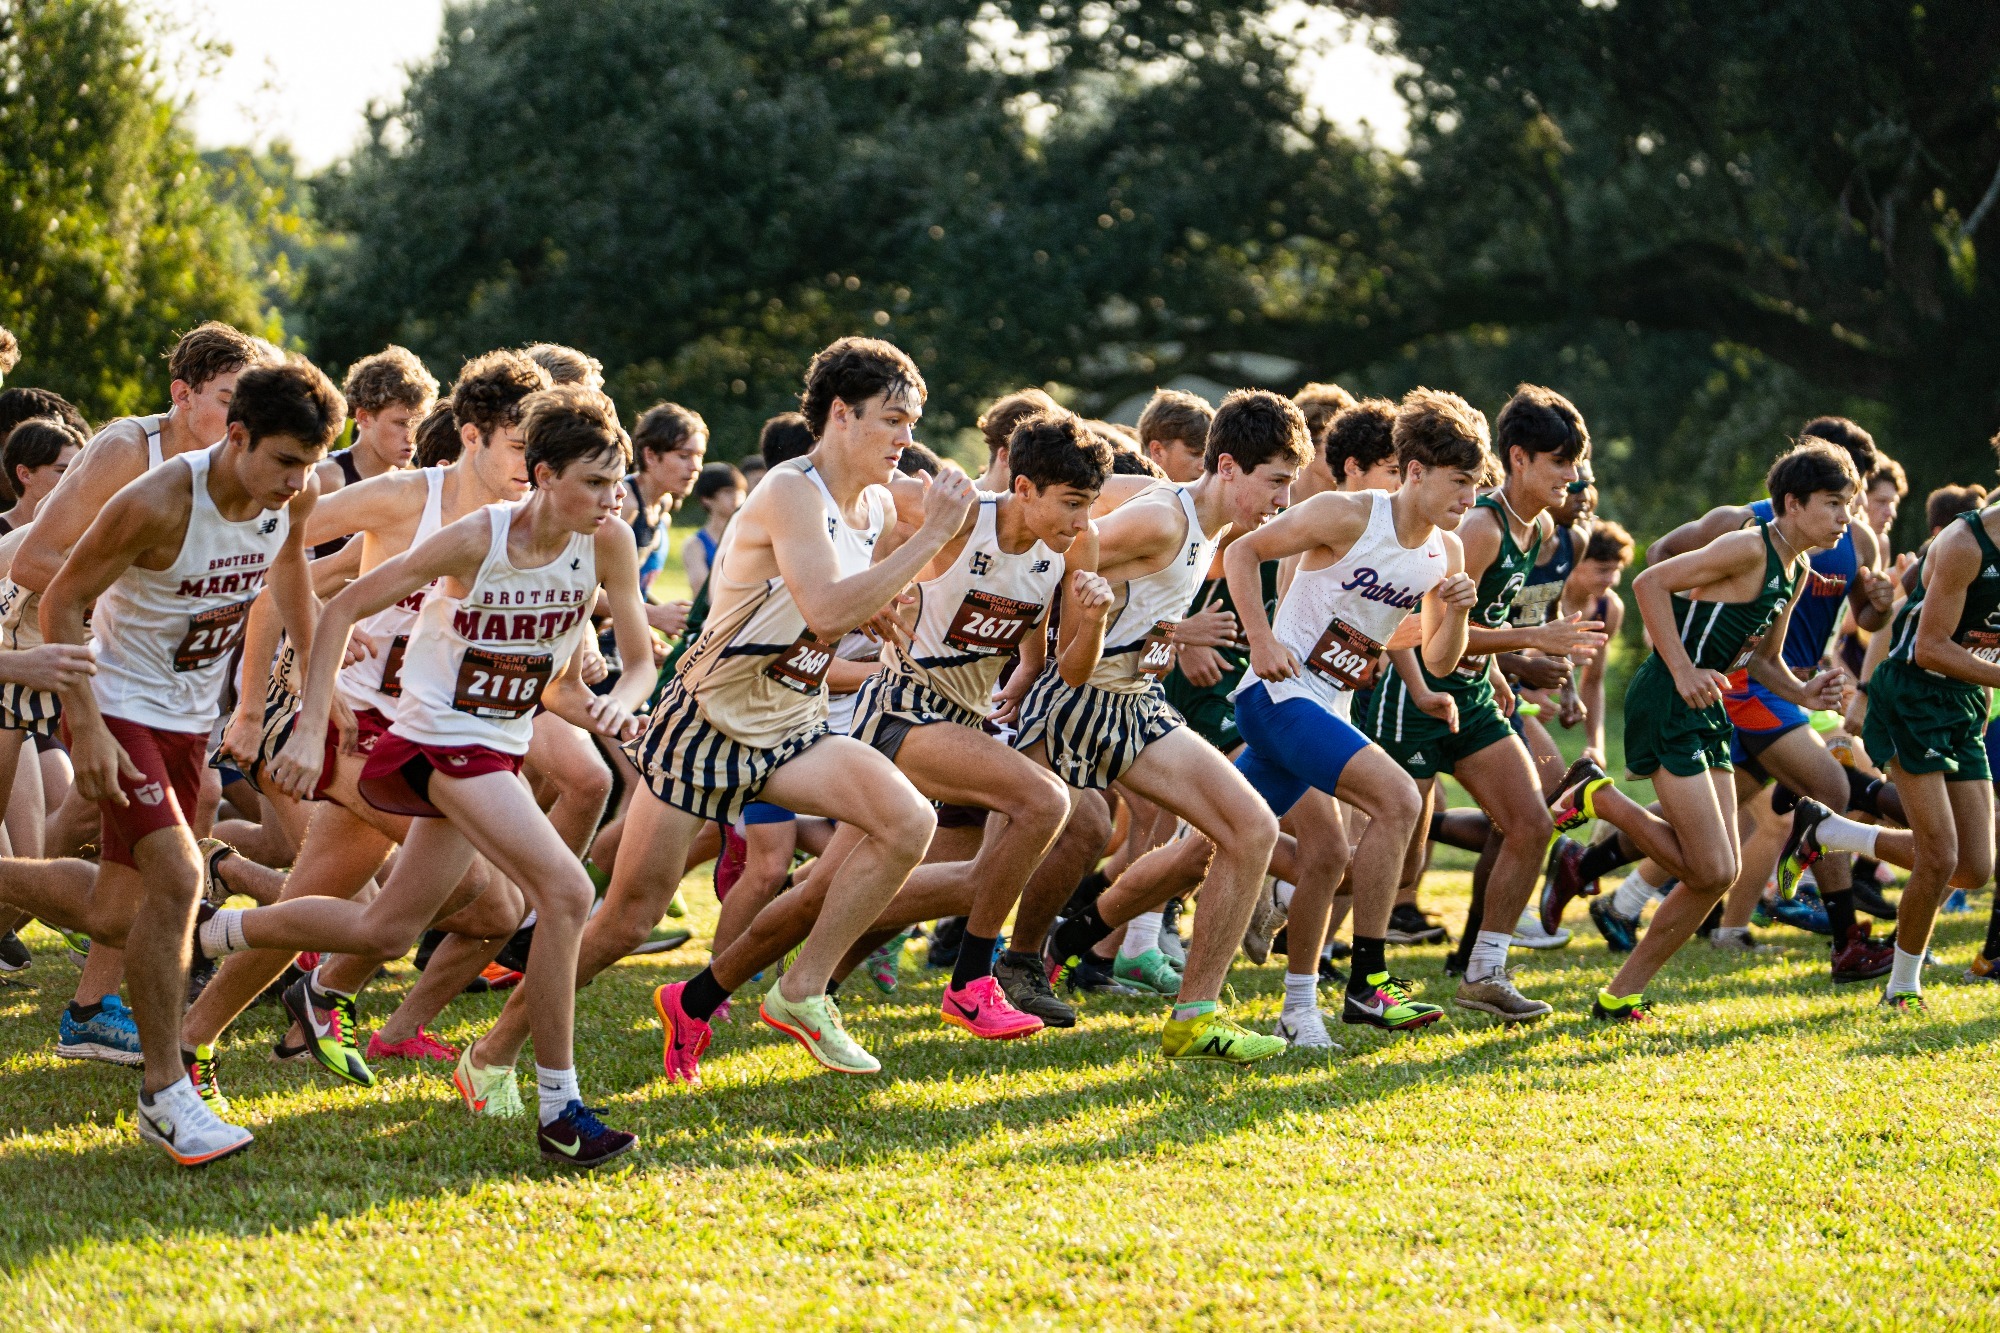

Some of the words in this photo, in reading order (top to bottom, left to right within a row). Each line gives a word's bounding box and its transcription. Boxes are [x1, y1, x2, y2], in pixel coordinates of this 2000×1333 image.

[208, 553, 265, 570] BROTHER
[176, 567, 270, 598] MARTI
[482, 589, 585, 605] BROTHER
[974, 591, 1018, 608] CRESCENT
[195, 602, 241, 622] CRESCENT
[989, 603, 1018, 616] TIMING
[188, 617, 245, 652] 217
[961, 611, 1024, 640] 2677
[1338, 621, 1371, 645] CRESCENT
[1143, 641, 1172, 666] 266
[1348, 635, 1369, 652] TIMING
[473, 650, 526, 664] CRESCENT
[527, 655, 548, 665] CITY
[493, 660, 528, 672] TIMING
[786, 645, 830, 675] 2669
[1320, 640, 1368, 679] 2692
[467, 670, 539, 701] 2118
[1202, 1035, 1235, 1056] N
